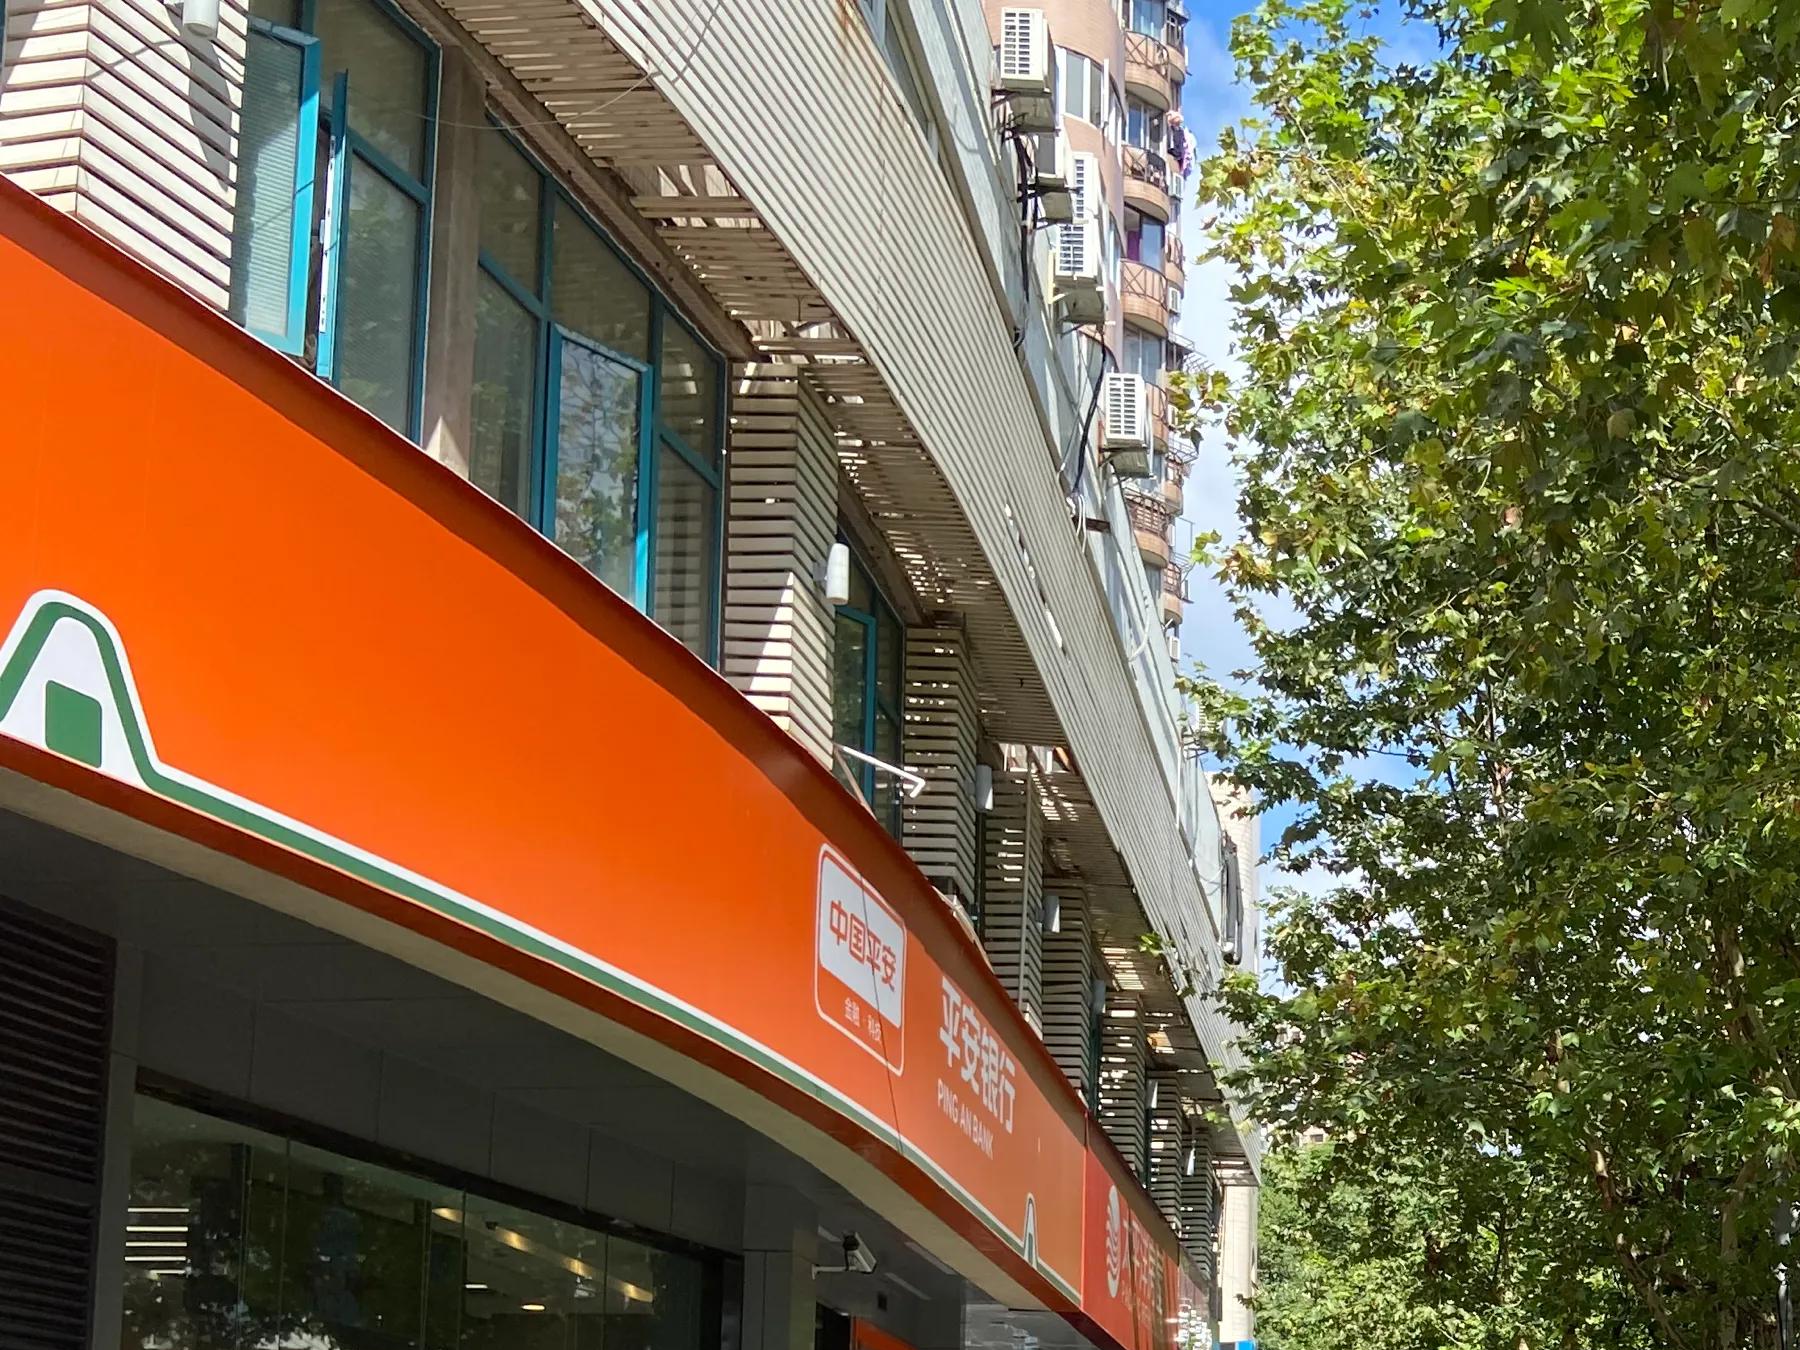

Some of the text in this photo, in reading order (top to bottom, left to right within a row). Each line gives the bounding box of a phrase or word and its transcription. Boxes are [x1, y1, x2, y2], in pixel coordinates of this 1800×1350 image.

[829, 900, 896, 992] 中国平安
[939, 976, 1015, 1135] 平安银行
[938, 1079, 993, 1159] PING AN BANK
